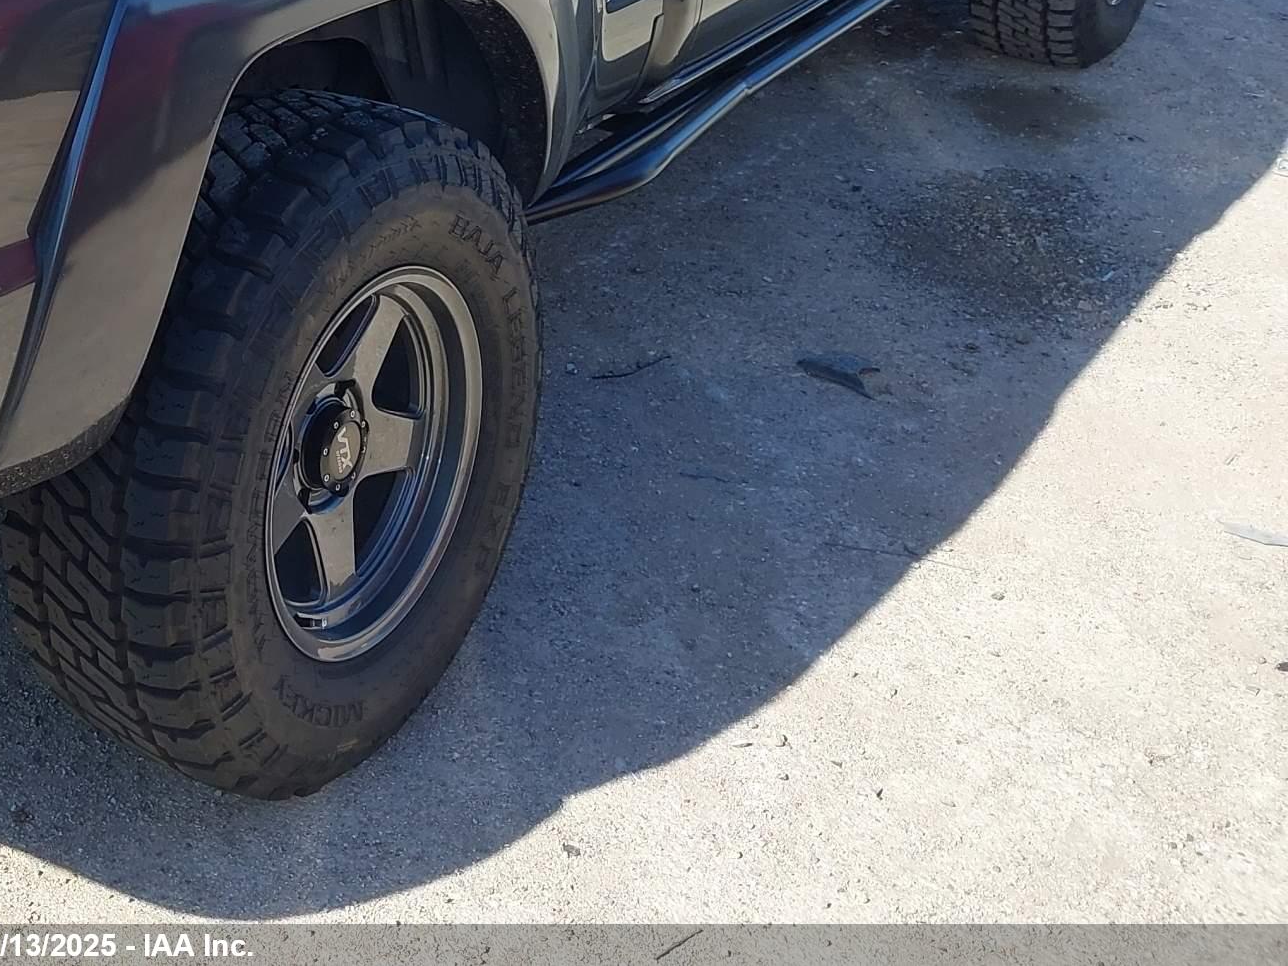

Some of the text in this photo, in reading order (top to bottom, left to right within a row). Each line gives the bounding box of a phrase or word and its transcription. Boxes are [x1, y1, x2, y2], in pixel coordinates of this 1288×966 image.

[448, 210, 506, 280] BAJA
[503, 286, 530, 449] LEGEND
[337, 426, 353, 468] VTX
[273, 674, 364, 727] MICKEY
